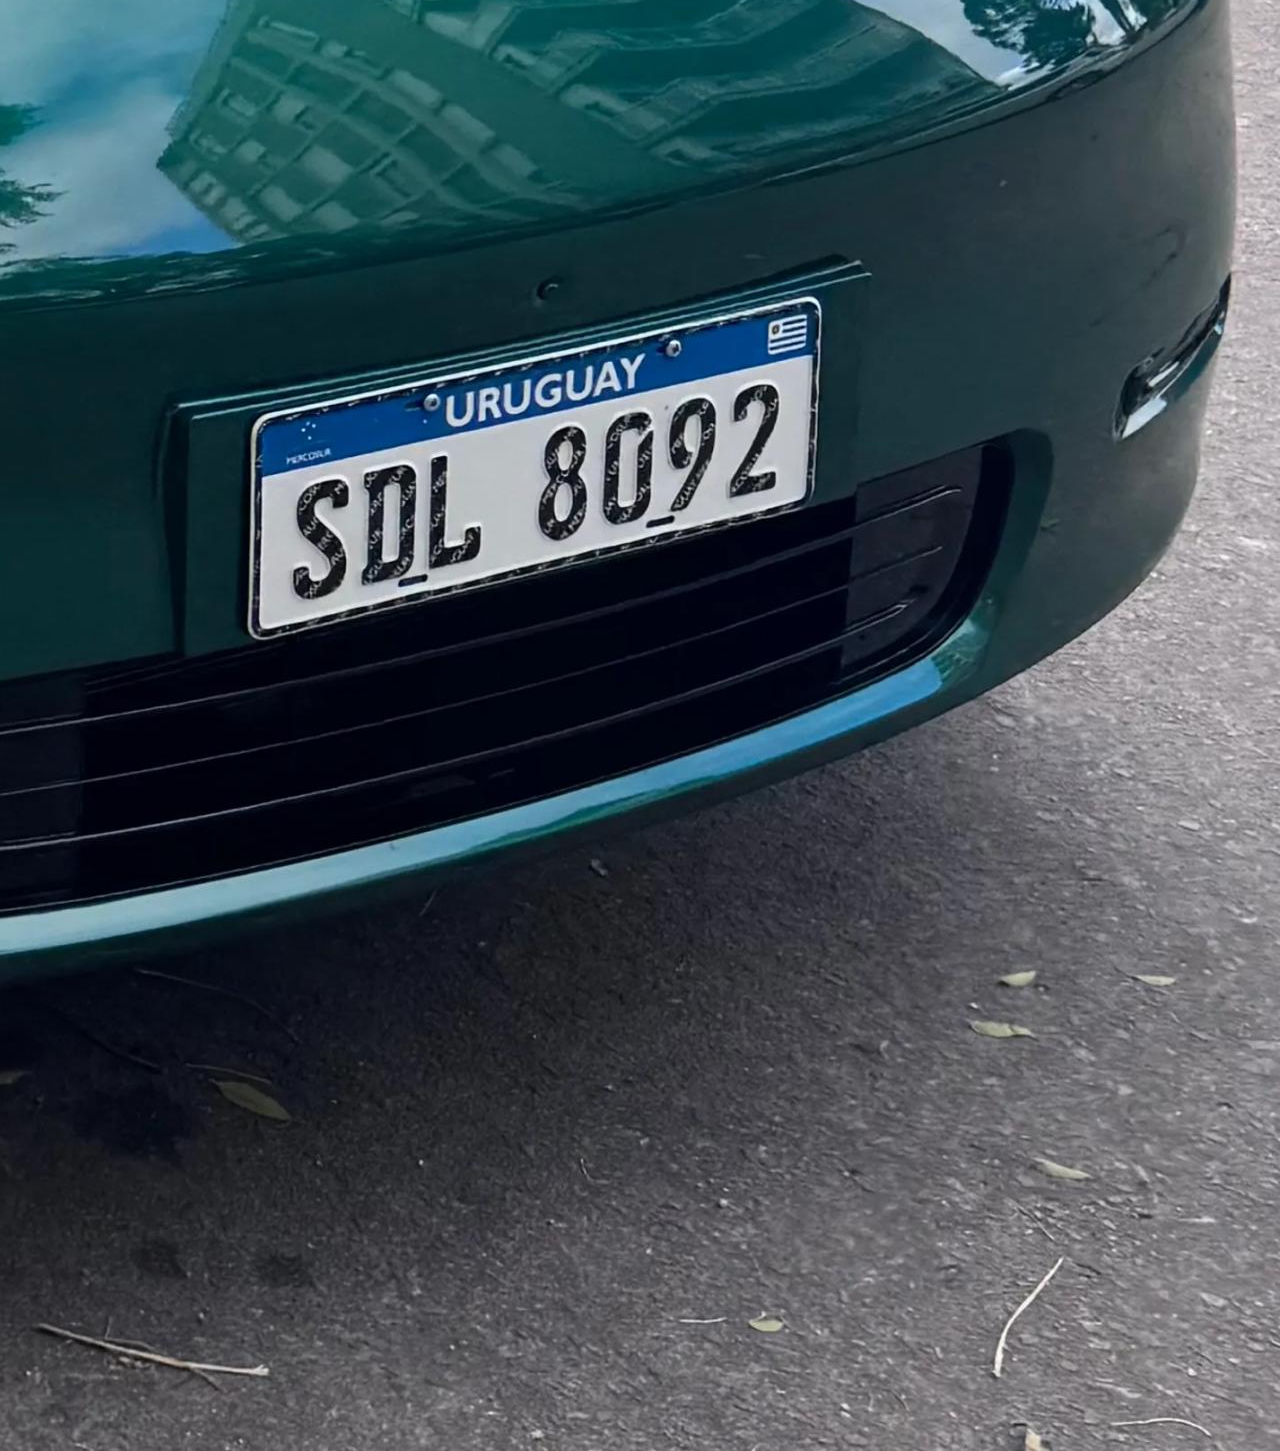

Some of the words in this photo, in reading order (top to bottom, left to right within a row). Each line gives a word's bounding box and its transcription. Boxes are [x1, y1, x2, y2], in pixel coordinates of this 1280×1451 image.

[445, 353, 646, 429] URUGUAY
[292, 454, 482, 600] SDL
[537, 383, 781, 542] 8092
